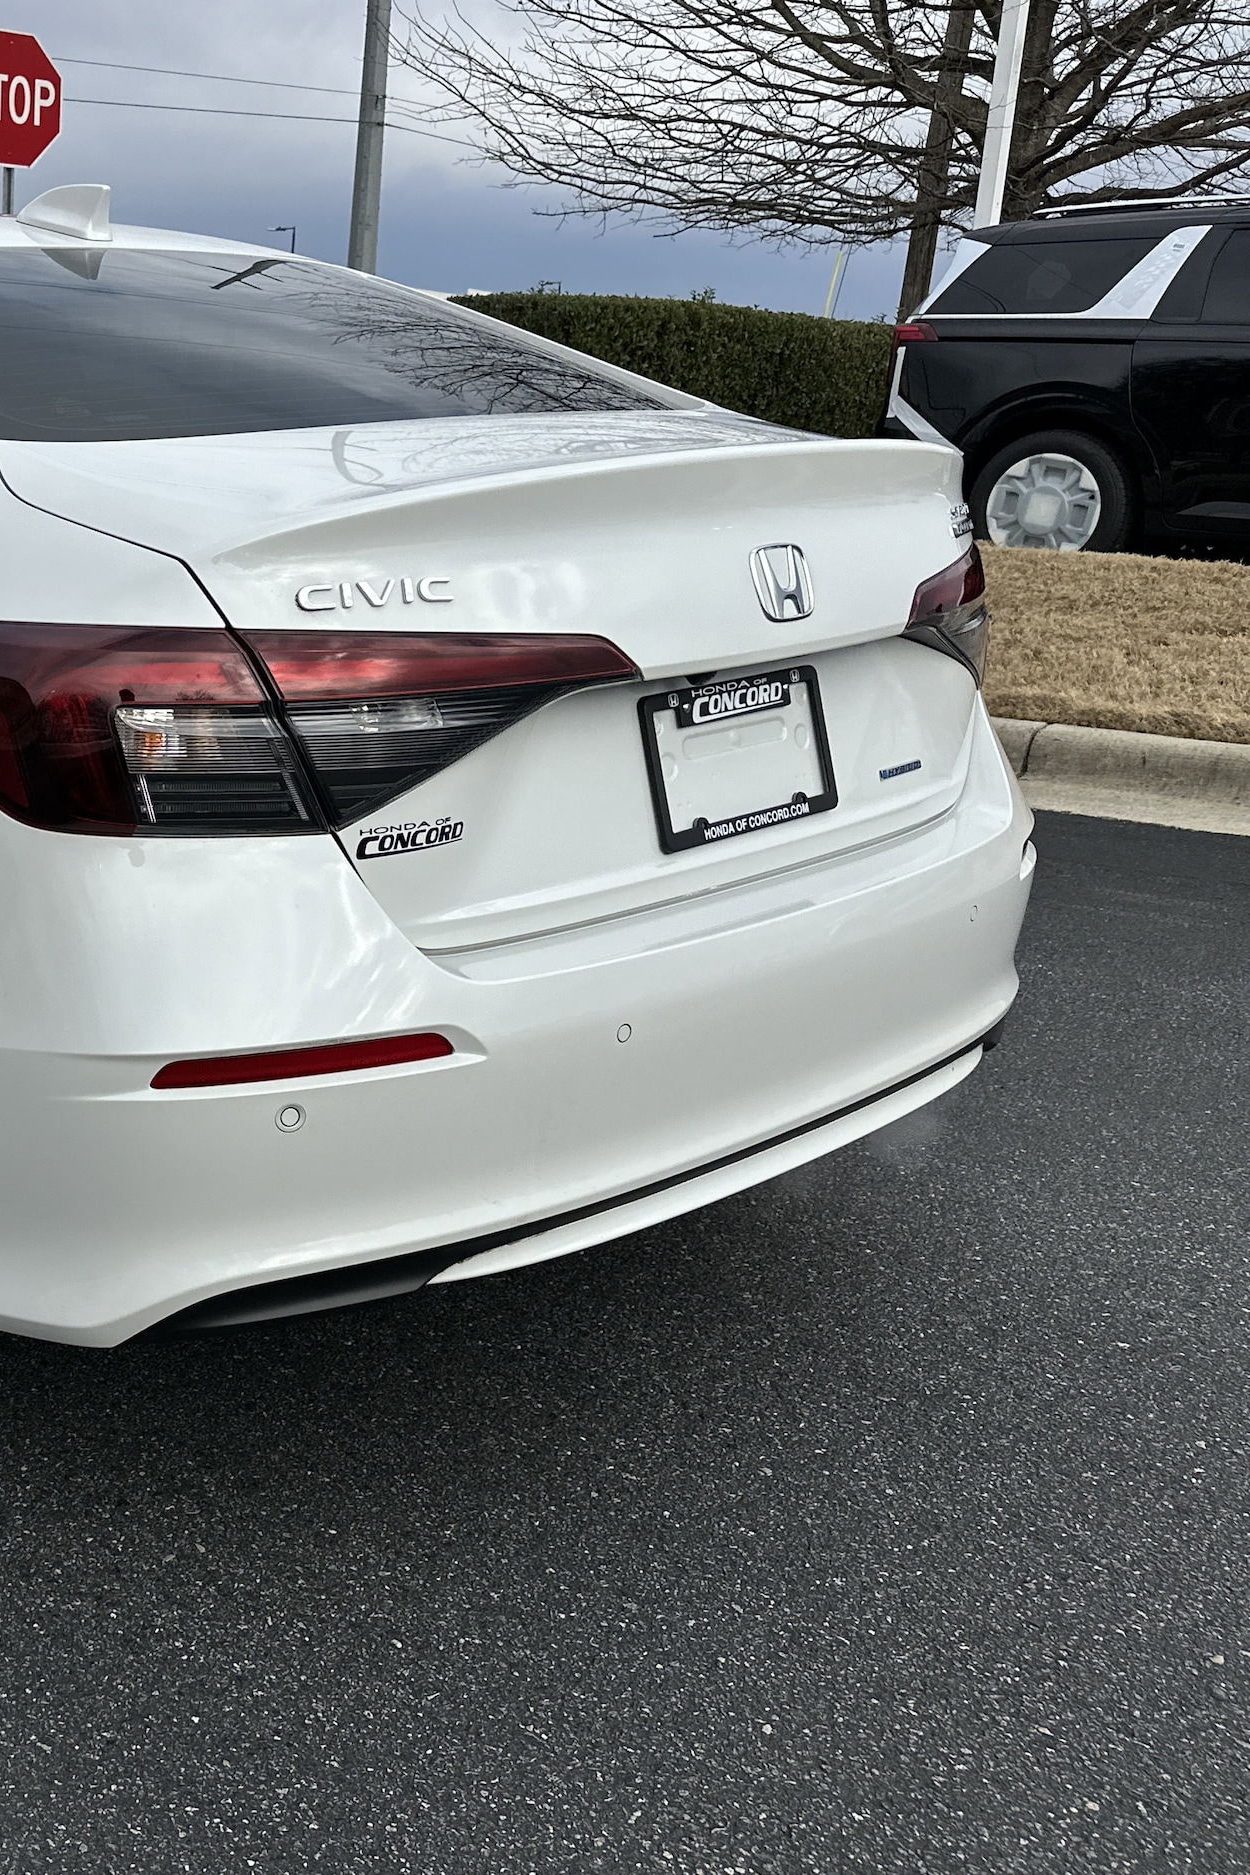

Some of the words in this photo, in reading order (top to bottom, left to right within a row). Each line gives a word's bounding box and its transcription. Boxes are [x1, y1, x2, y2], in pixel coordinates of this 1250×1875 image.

[296, 577, 454, 611] CIVIC
[691, 680, 750, 697] HONDA
[753, 678, 767, 686] OF
[692, 682, 784, 724] CONCORD
[359, 821, 431, 836] HONDA
[435, 816, 452, 826] OF
[704, 823, 735, 840] HONDA
[736, 819, 748, 831] OF
[749, 802, 810, 828] CONCORD.COM
[356, 821, 464, 860] CONCORD
